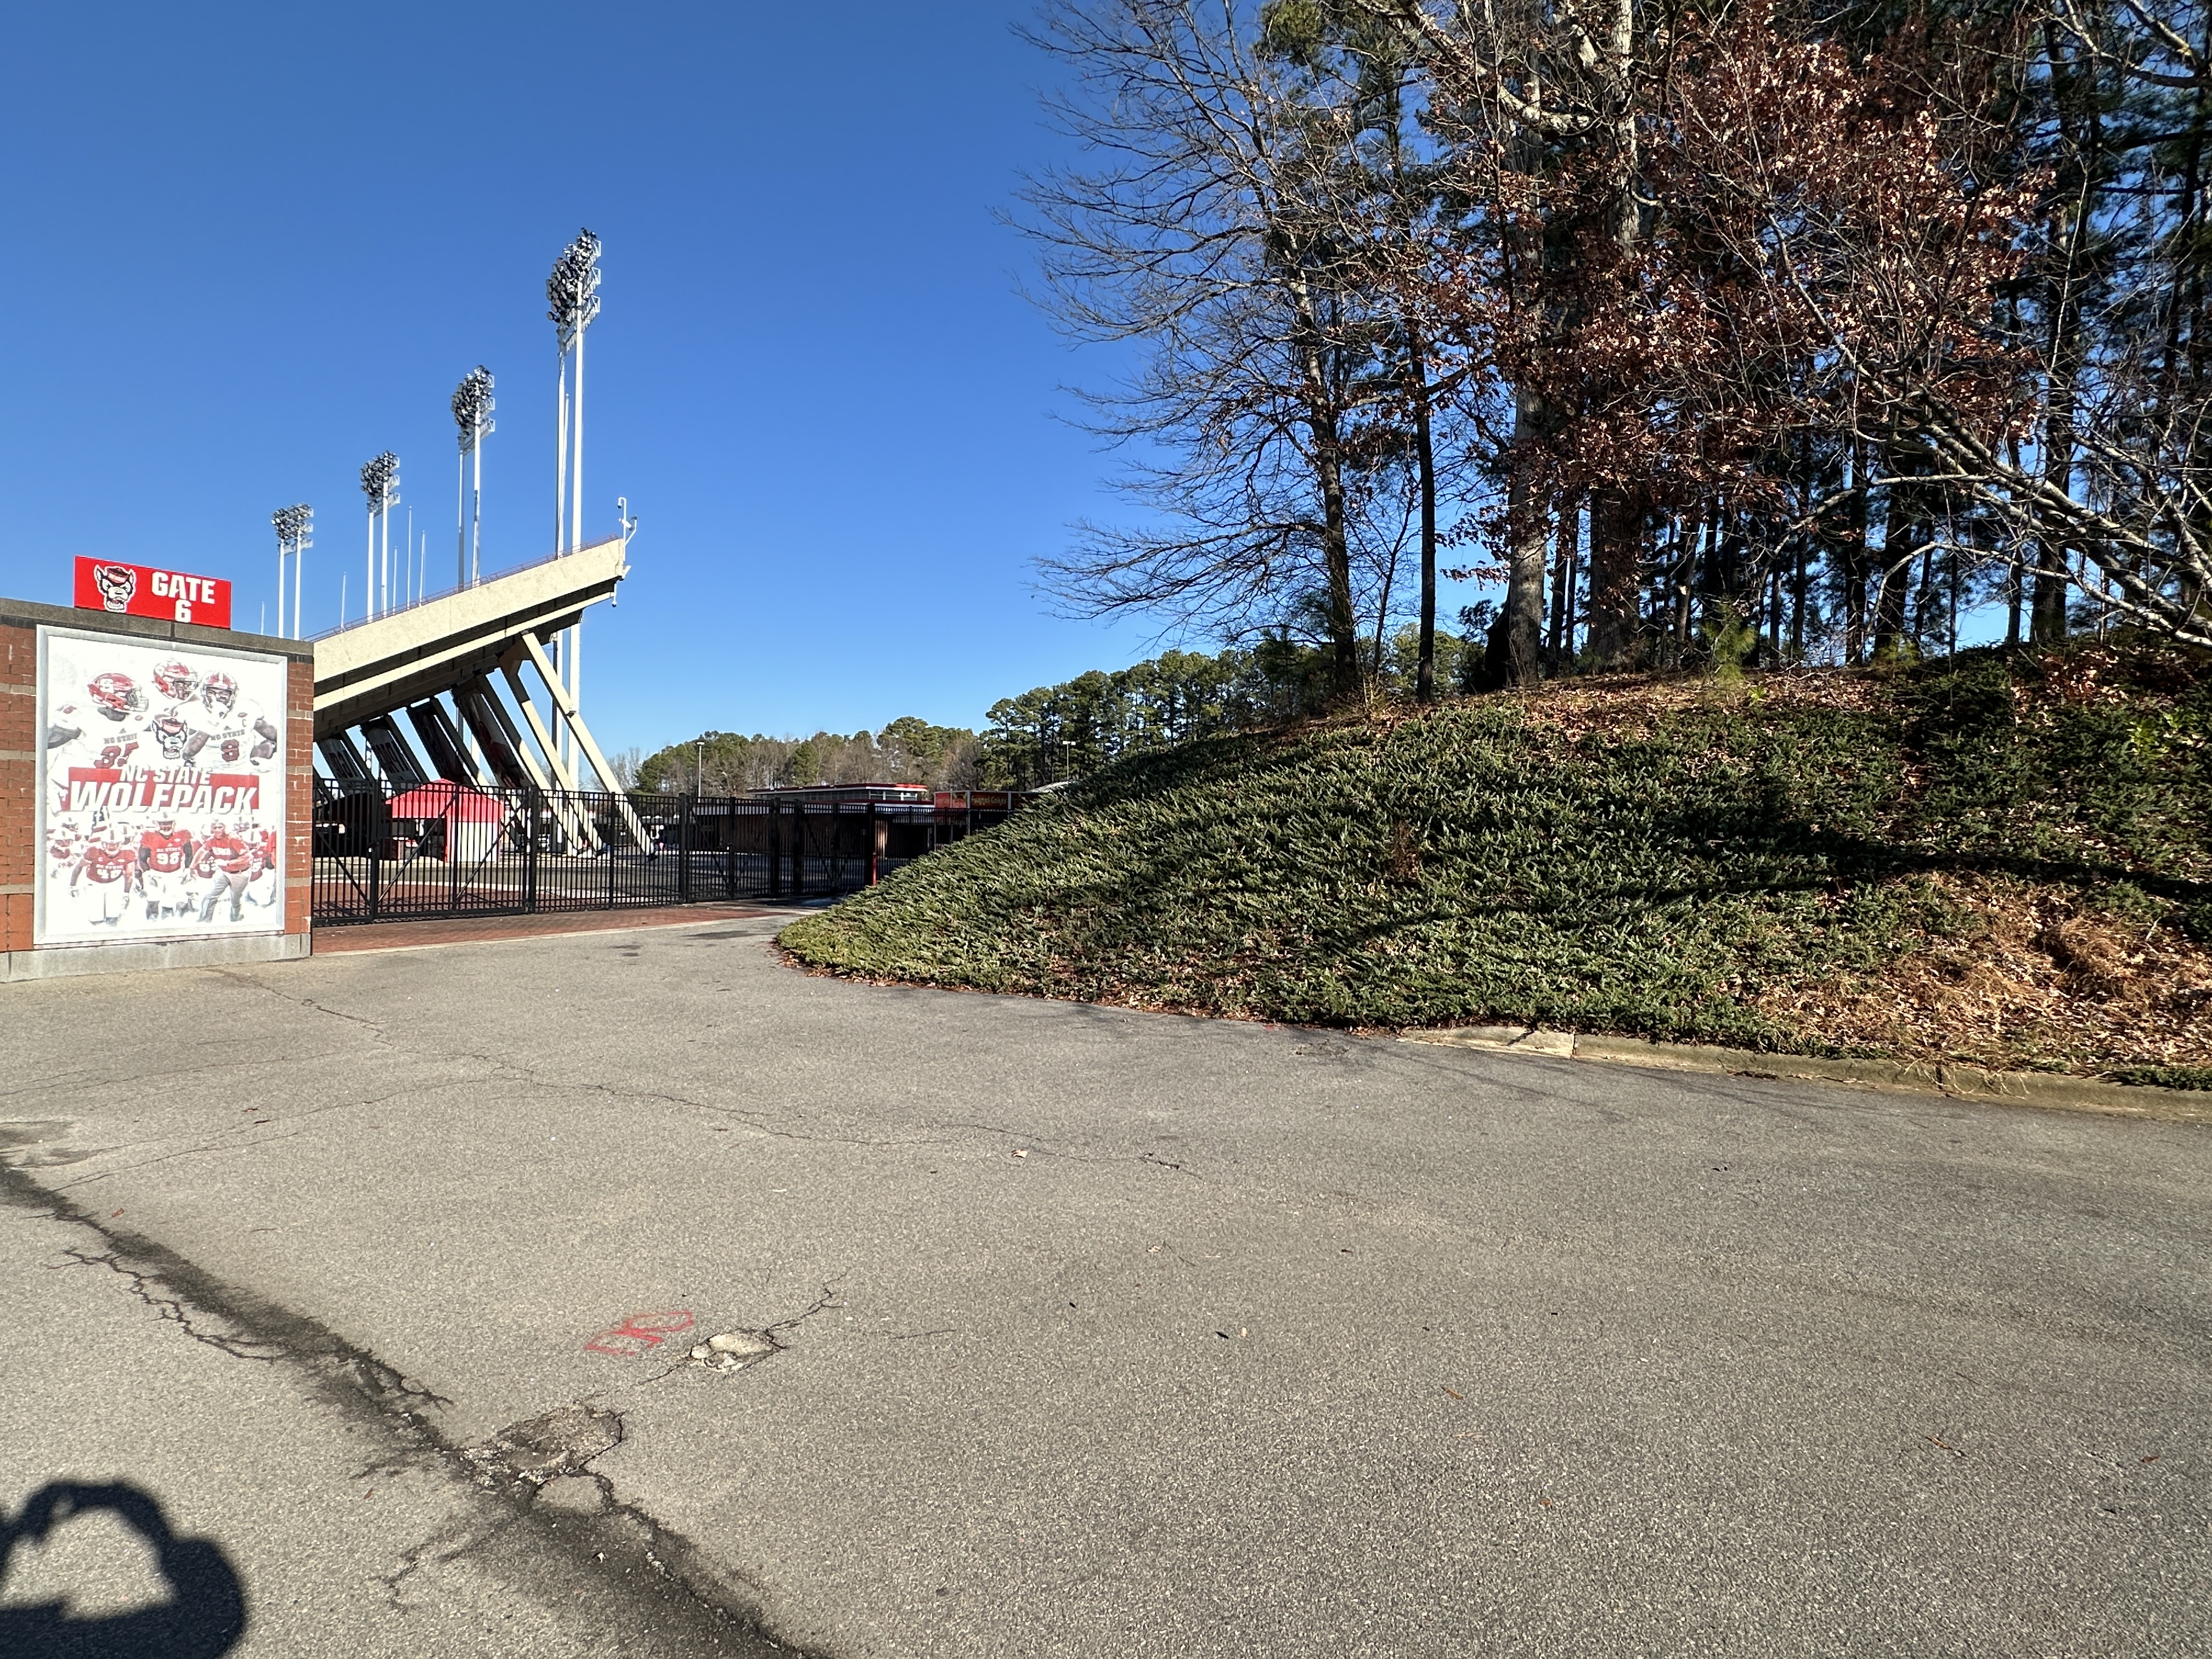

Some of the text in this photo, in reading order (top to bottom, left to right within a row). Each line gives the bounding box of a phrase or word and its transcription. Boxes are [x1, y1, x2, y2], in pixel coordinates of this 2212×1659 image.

[152, 571, 216, 604] GATE
[175, 599, 191, 623] 6
[120, 765, 211, 785] NC STATE
[69, 781, 258, 815] WOLFPACK
